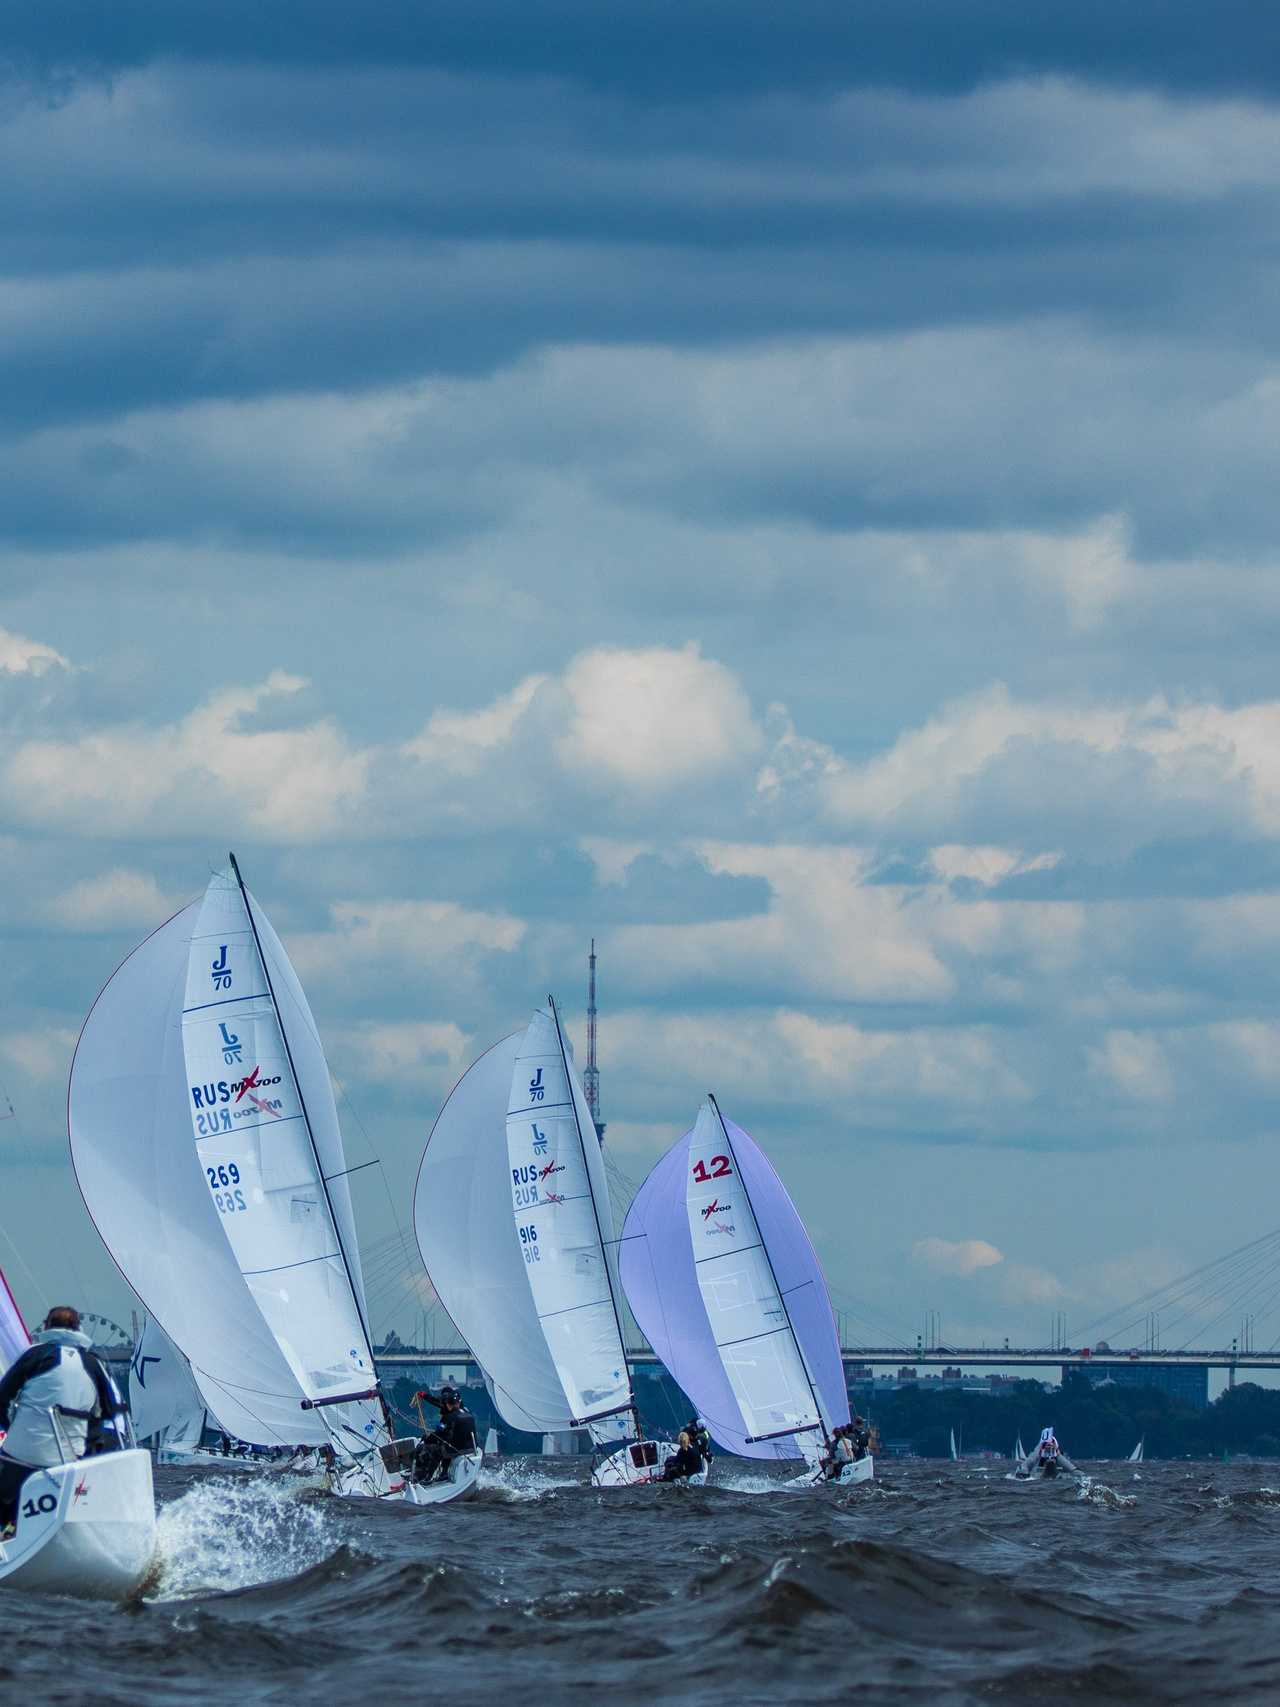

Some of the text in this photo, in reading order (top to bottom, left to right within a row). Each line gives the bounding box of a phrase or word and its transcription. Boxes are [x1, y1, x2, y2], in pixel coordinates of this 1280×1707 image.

[212, 945, 228, 971] J
[213, 975, 232, 991] 70
[230, 1065, 282, 1104] MX700
[530, 1068, 543, 1087] J
[191, 1081, 231, 1109] RUS
[530, 1090, 545, 1102] 70
[207, 1163, 240, 1189] 269
[512, 1164, 538, 1186] RUS
[692, 1156, 732, 1183] 12
[520, 1225, 537, 1244] 916
[22, 1494, 58, 1519] 10
